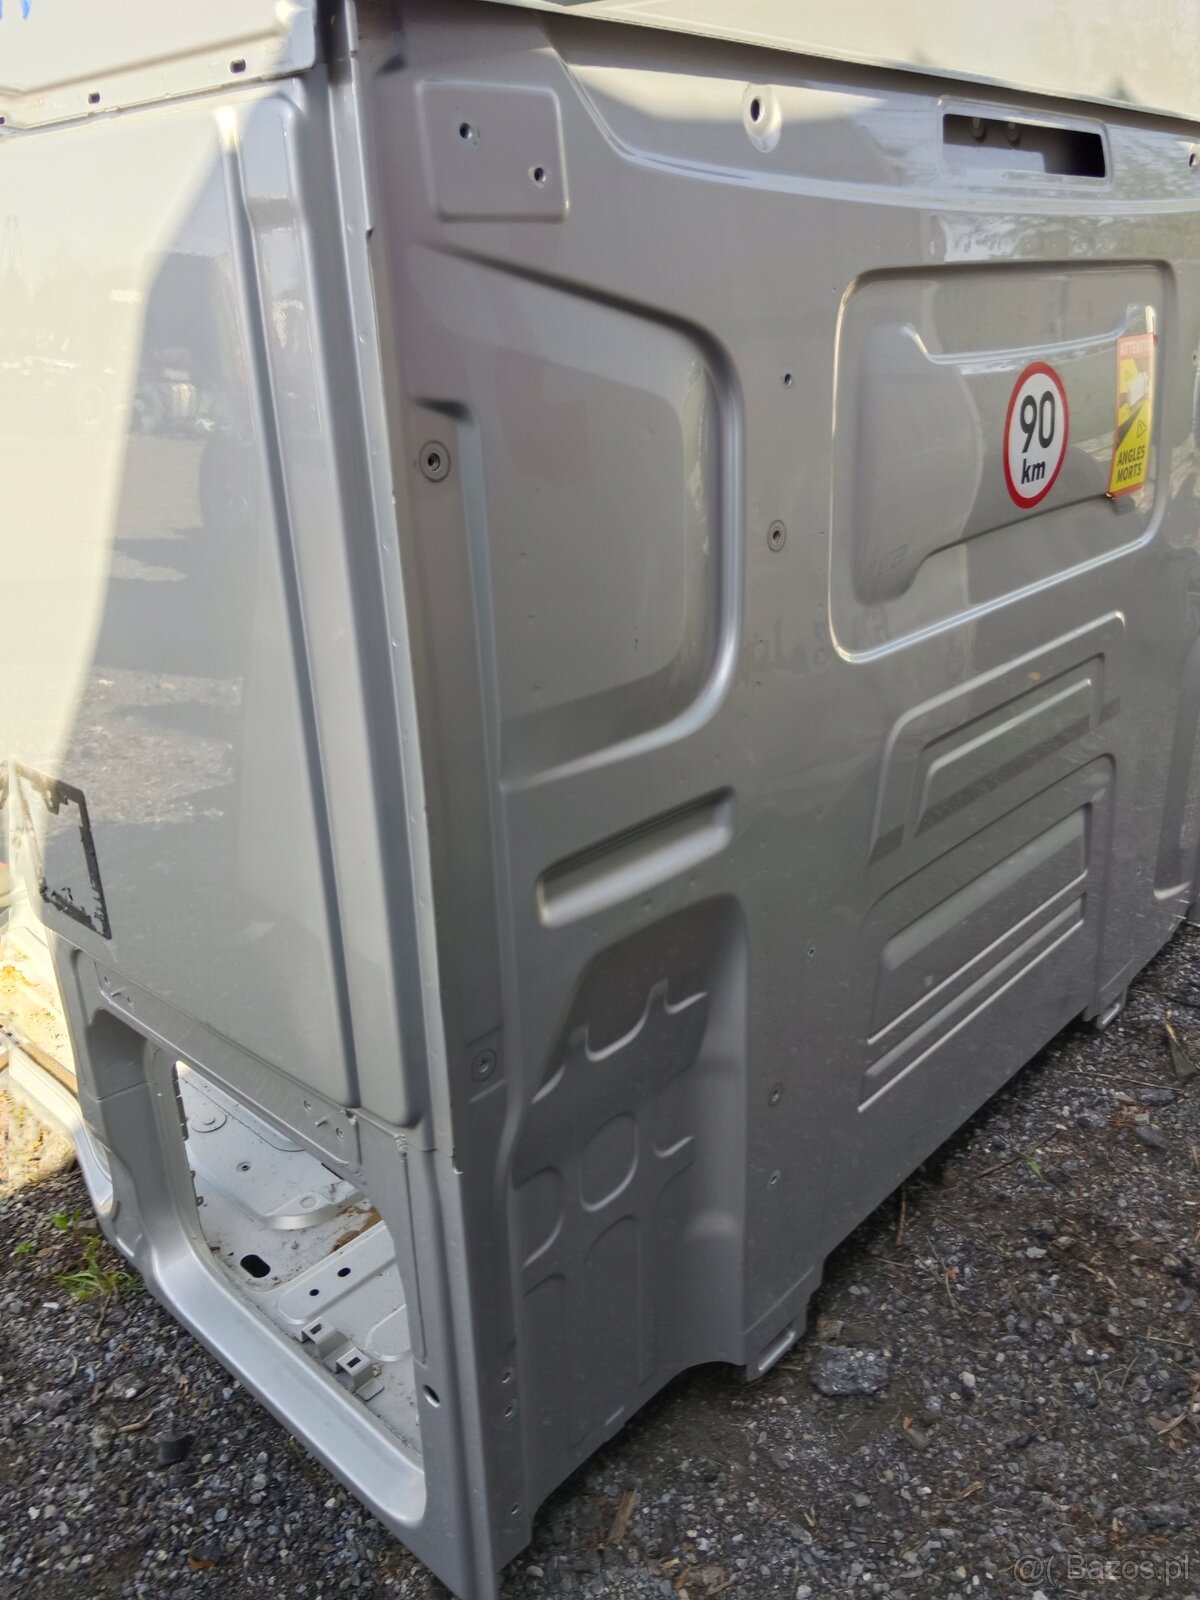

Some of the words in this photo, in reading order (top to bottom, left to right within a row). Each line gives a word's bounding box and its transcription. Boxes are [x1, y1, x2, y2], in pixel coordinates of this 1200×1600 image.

[1020, 391, 1055, 453] 90
[1117, 445, 1145, 467] ANGLES
[1021, 459, 1045, 484] km
[1116, 463, 1142, 483] MORTS
